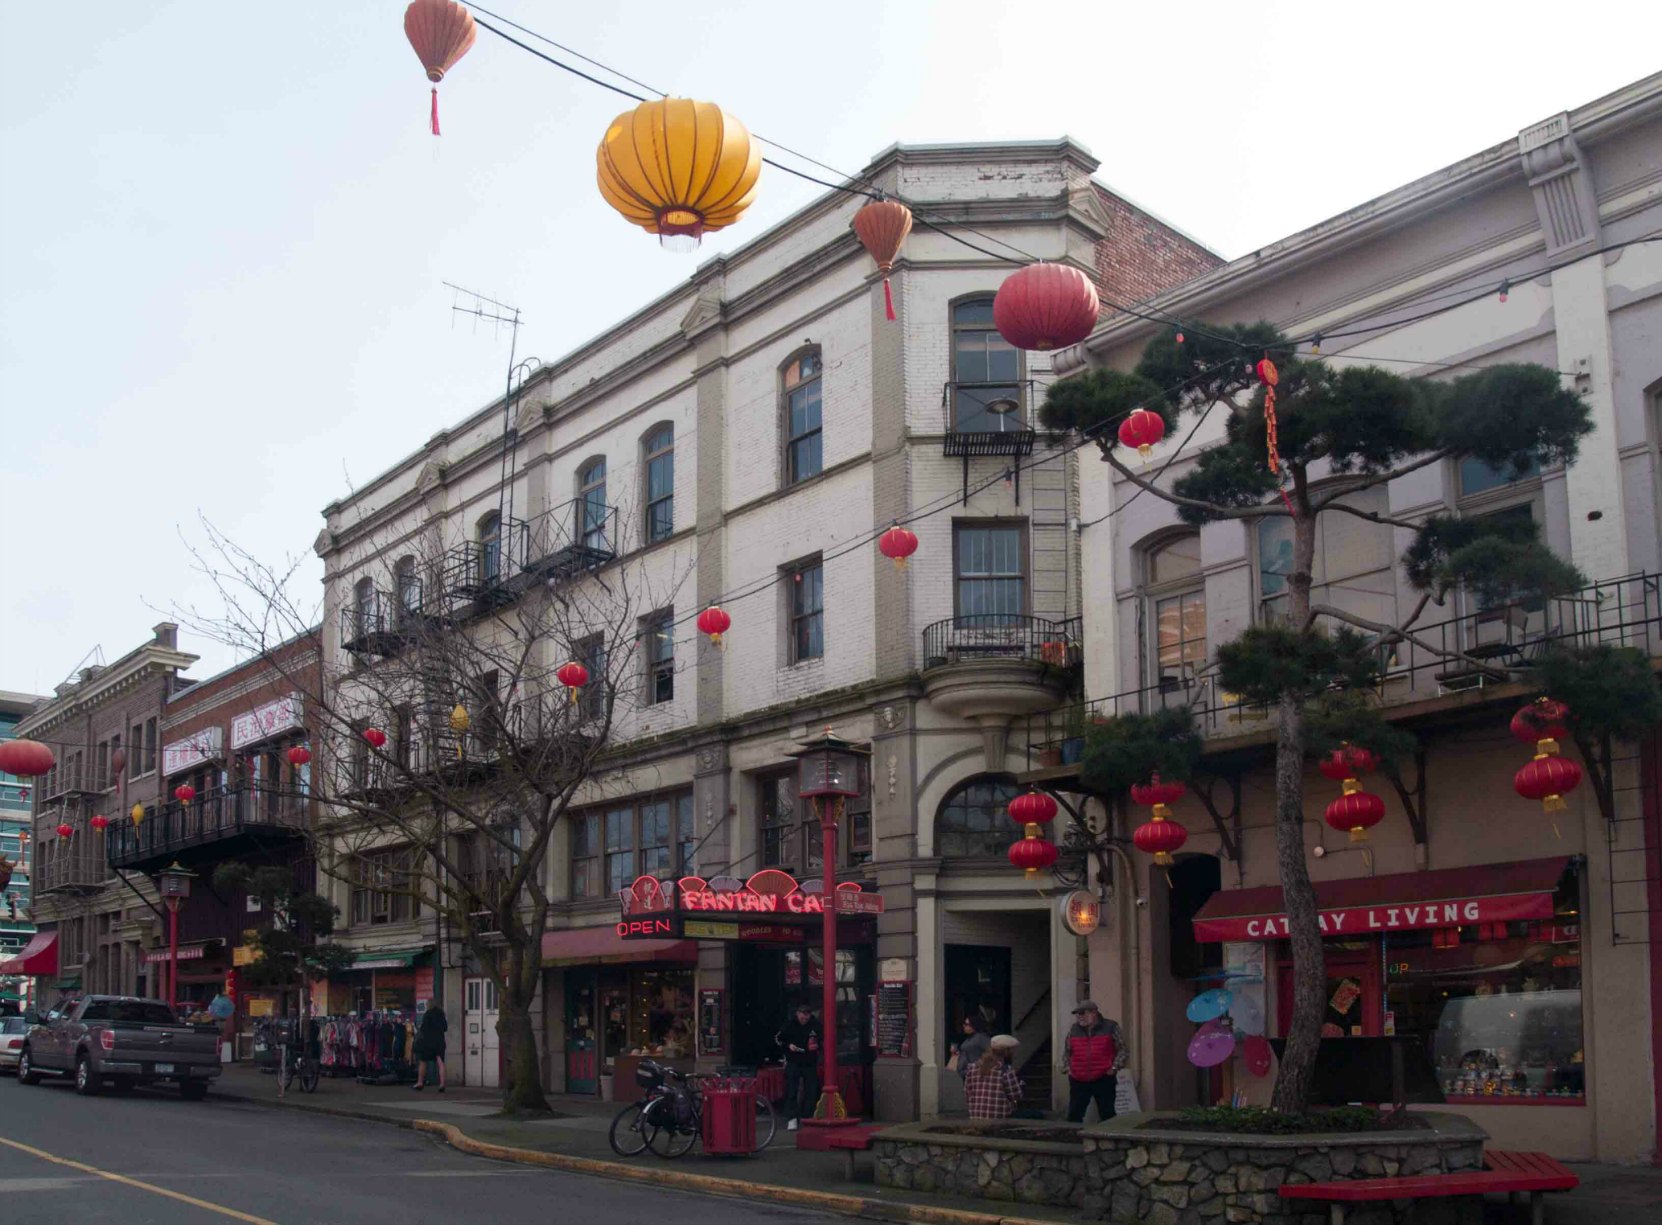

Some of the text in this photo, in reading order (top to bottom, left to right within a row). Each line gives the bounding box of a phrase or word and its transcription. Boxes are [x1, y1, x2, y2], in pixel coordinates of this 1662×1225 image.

[681, 890, 777, 912] FANTAN
[616, 918, 671, 937] OPEN
[1246, 901, 1479, 937] CATAY LIVING
